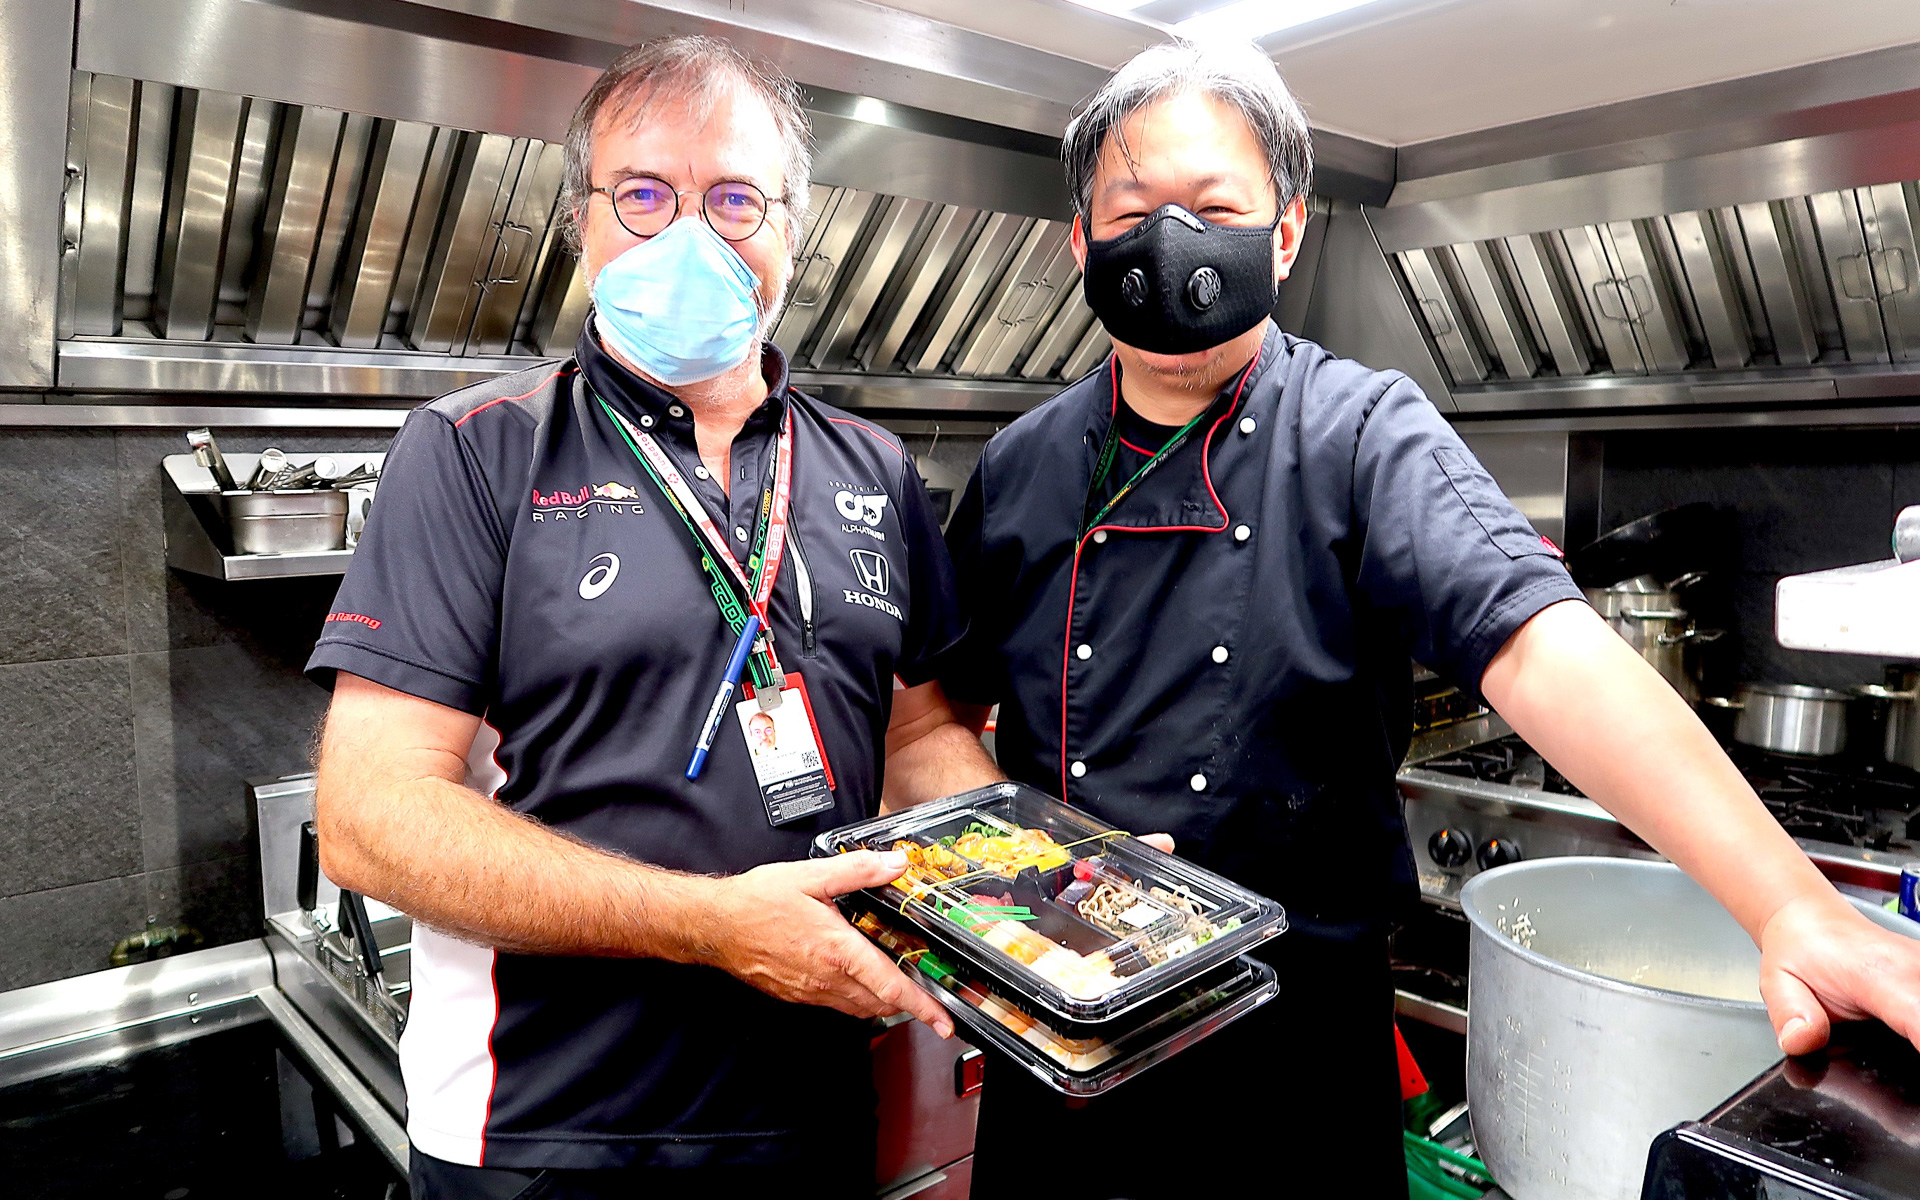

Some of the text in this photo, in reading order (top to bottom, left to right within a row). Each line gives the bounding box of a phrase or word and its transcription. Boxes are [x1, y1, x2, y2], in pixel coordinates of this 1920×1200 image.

[532, 485, 591, 507] Red Bull
[532, 503, 645, 523] RACING
[842, 589, 904, 622] HONDA
[336, 611, 382, 630] Racing
